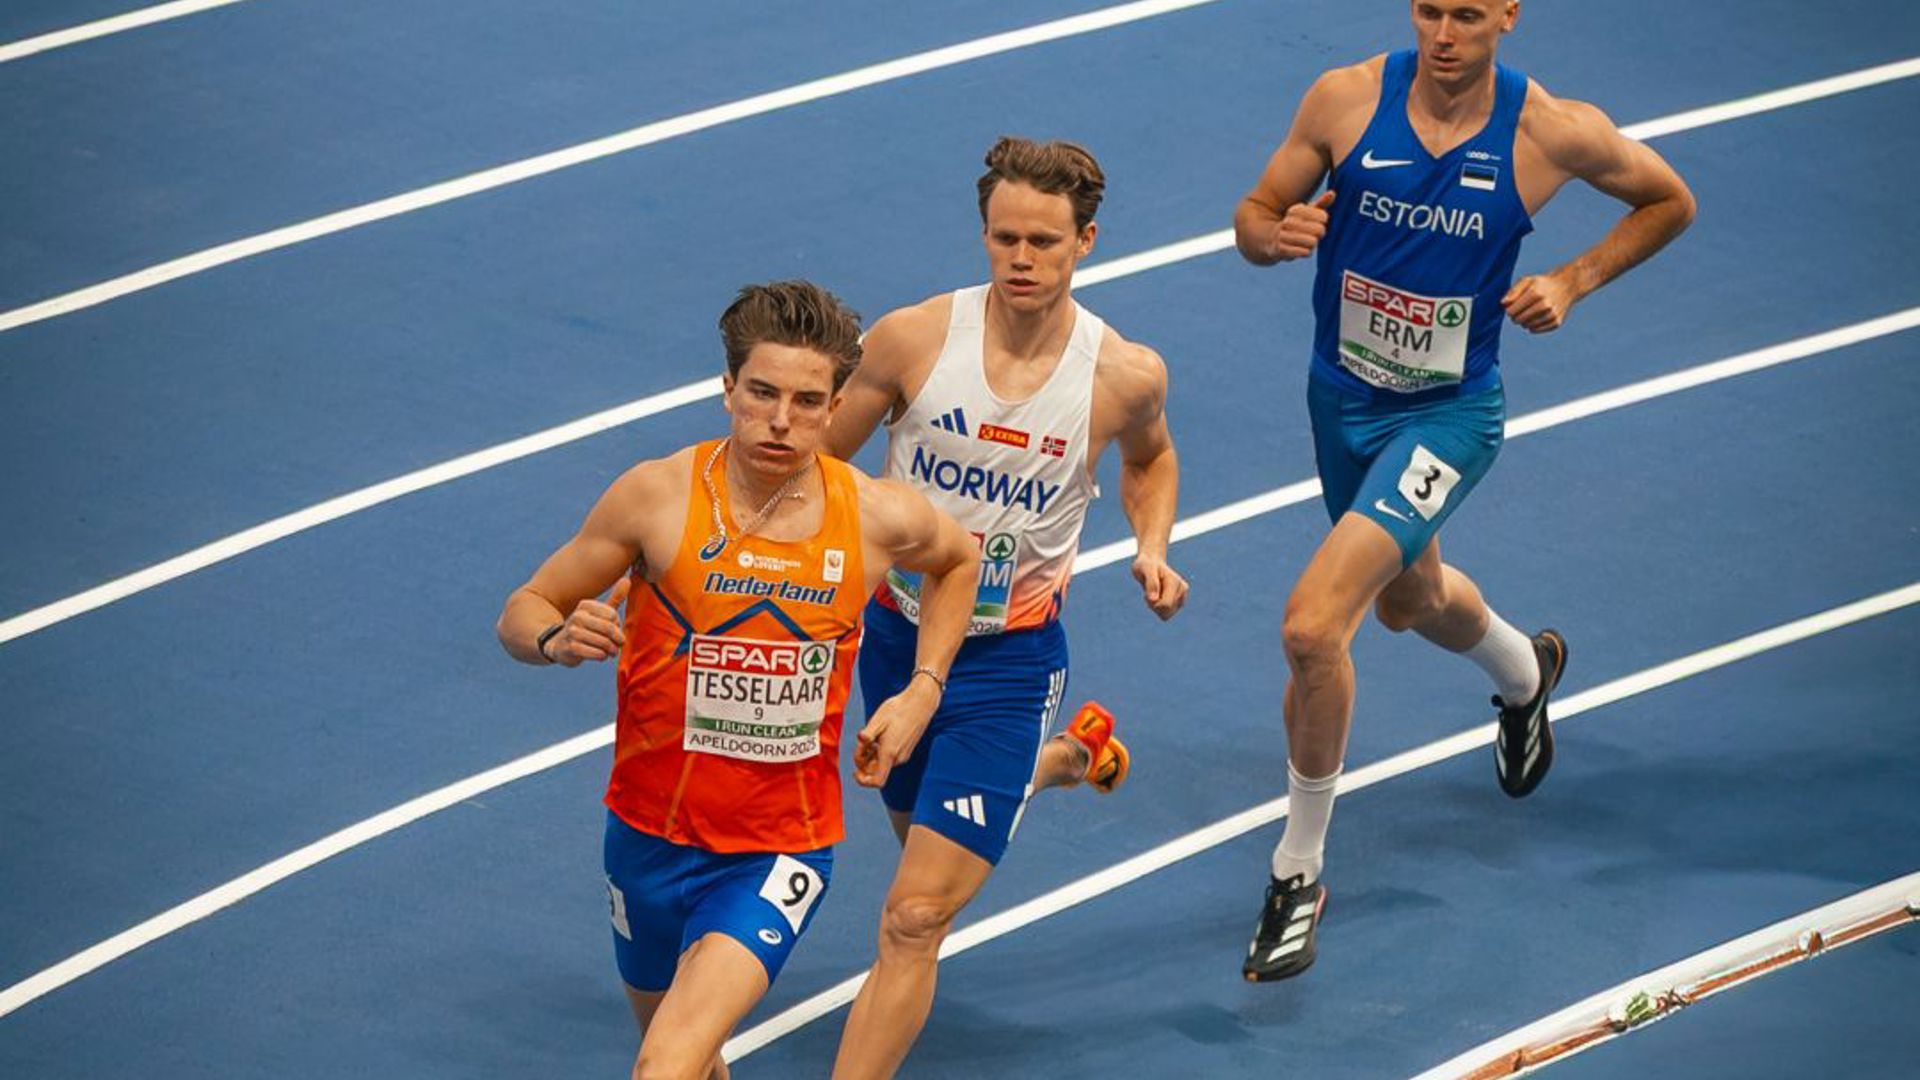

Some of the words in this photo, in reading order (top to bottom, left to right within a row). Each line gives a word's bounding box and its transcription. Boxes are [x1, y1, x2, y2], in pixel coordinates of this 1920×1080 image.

[1359, 190, 1484, 240] ESTONIA
[1344, 277, 1432, 325] SPAR
[1369, 311, 1433, 353] ERM
[911, 445, 1061, 514] NORWAY
[1414, 464, 1441, 500] 3
[704, 572, 837, 605] Nederland
[694, 642, 797, 672] SPAR
[689, 670, 824, 706] TESSELAAR
[721, 721, 751, 734] RUN
[753, 725, 797, 737] CLEAN
[754, 707, 764, 720] 9
[689, 733, 787, 757] APELDOORN
[781, 872, 810, 907] 9
